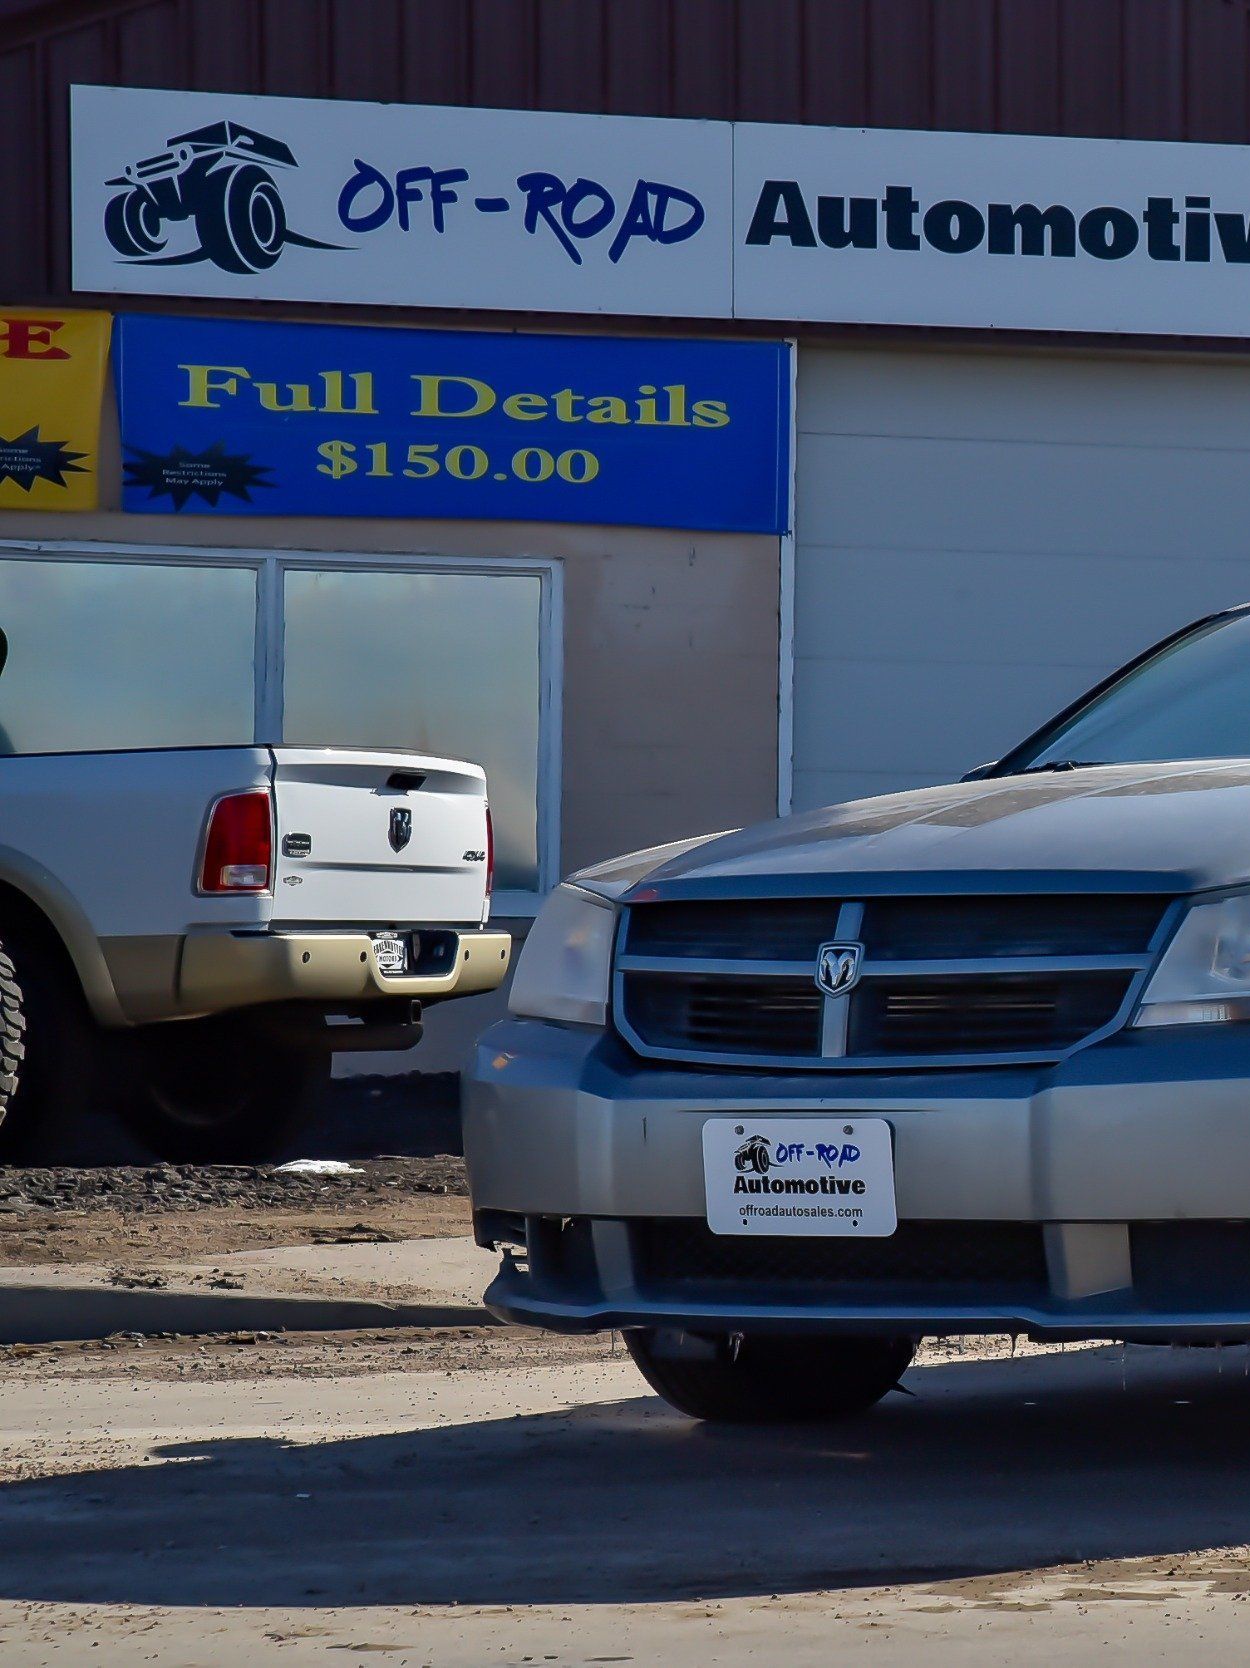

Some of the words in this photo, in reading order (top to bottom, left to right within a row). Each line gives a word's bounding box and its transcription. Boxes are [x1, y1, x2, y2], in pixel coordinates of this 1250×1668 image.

[338, 158, 706, 265] OFF-ROAD
[178, 364, 379, 415] Full
[410, 374, 731, 428] Details
[179, 461, 211, 469] Some
[316, 440, 600, 484] $150.00
[162, 469, 227, 478] Restrictions
[165, 477, 189, 486] May
[191, 478, 224, 488] Apply
[776, 1143, 861, 1169] OFF-ROAD
[733, 1175, 866, 1195] Automotive
[739, 1204, 863, 1218] offroadautosales.com
